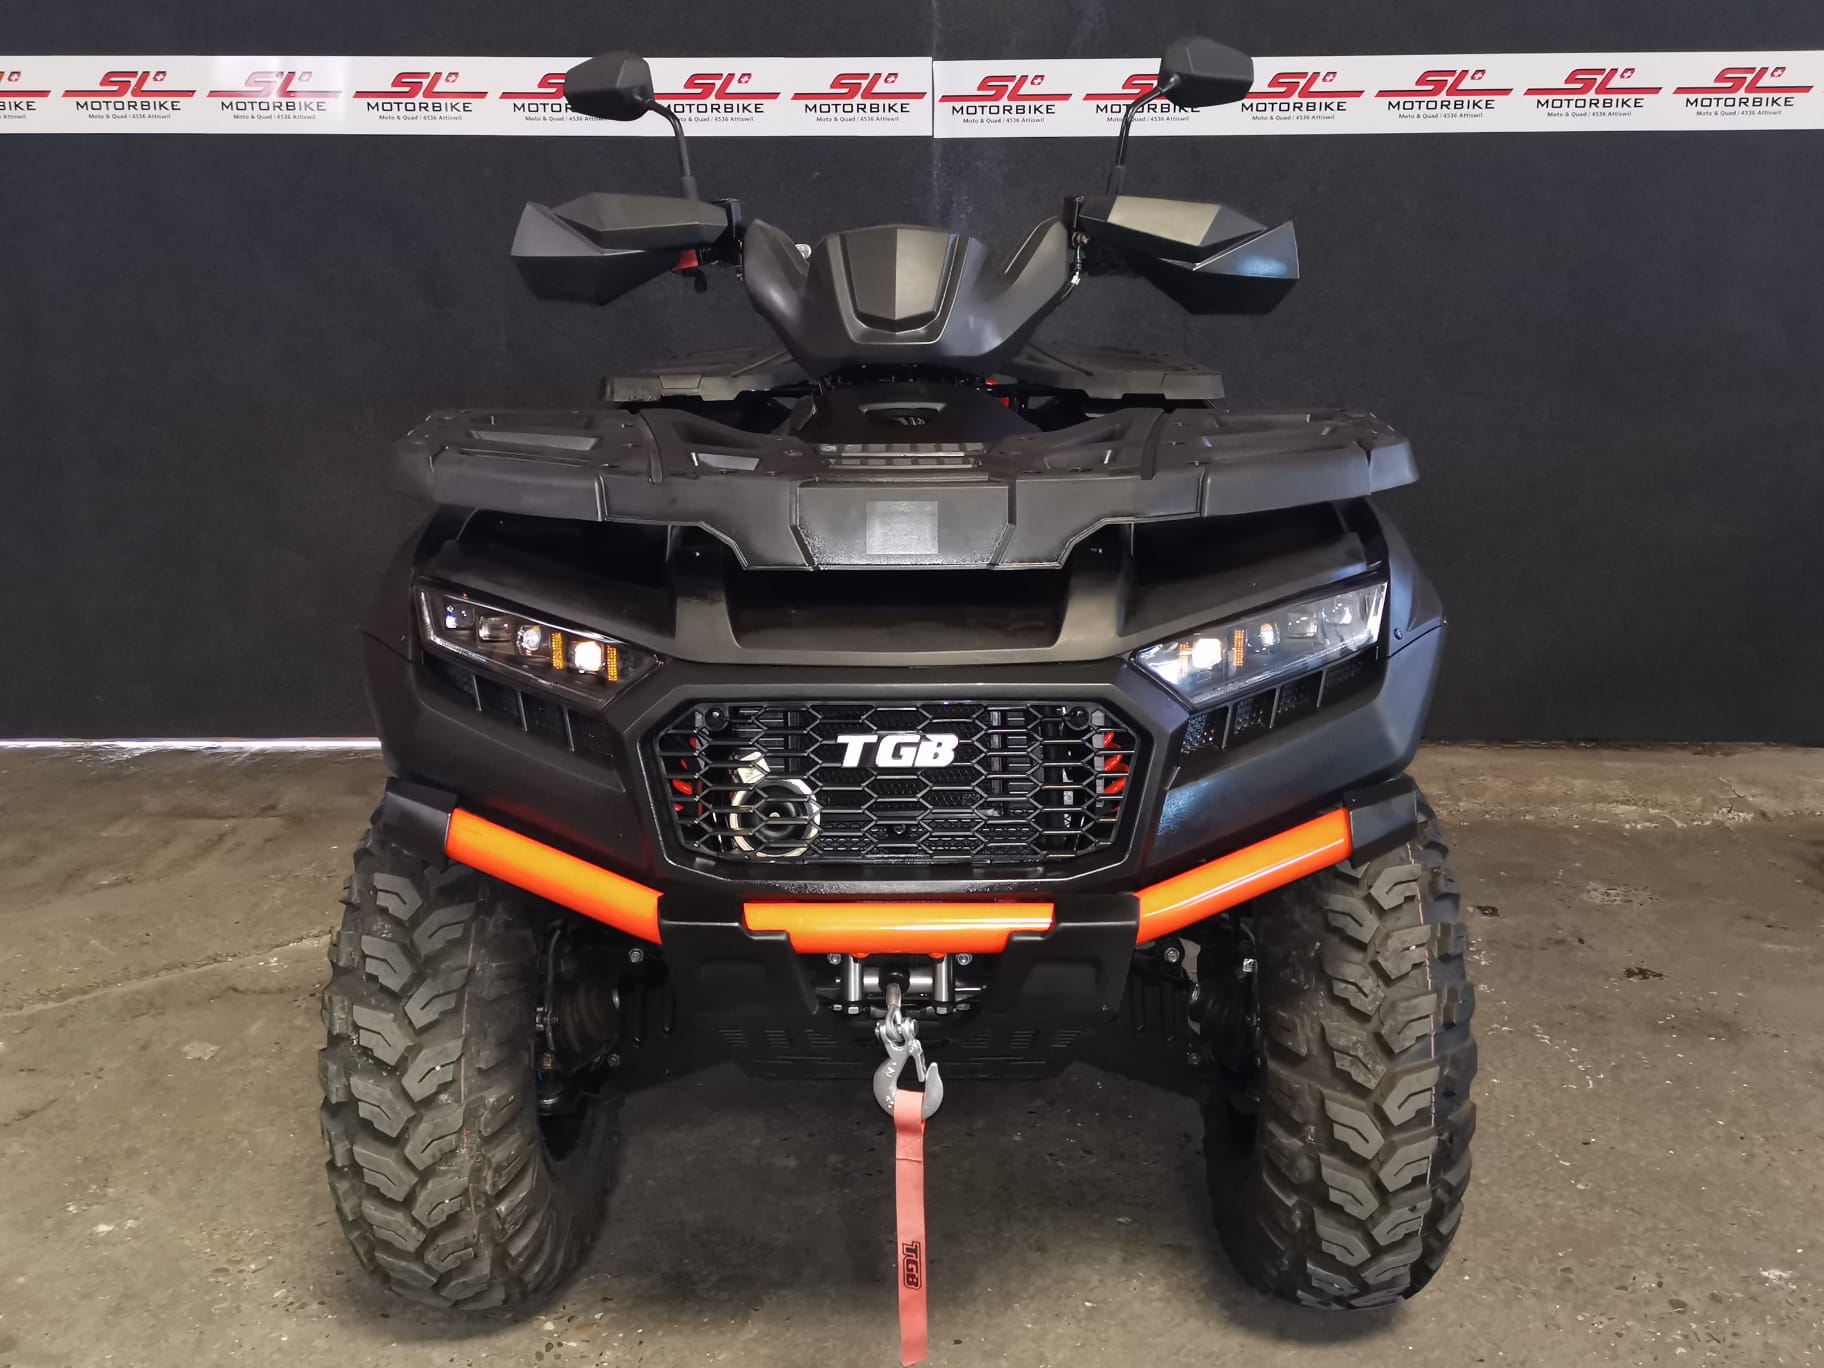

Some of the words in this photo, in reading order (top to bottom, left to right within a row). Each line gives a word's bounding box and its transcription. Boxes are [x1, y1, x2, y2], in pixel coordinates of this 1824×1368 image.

[76, 101, 181, 111] MOTORBIKE
[221, 101, 326, 111] MOTORBIKE
[367, 102, 472, 112] MOTORBIKE
[1241, 101, 1346, 112] MOTORBIKE
[1388, 100, 1495, 110] MOTORBIKE
[1537, 98, 1644, 108] MOTORBIKE
[1686, 97, 1794, 107] MOTORBIKE
[668, 103, 764, 113] OTORBIKE
[805, 103, 910, 113] MOTORBIKE
[952, 105, 1055, 115] MOTORBIKE
[837, 733, 959, 768] TGB
[904, 1242, 920, 1289] TGB
